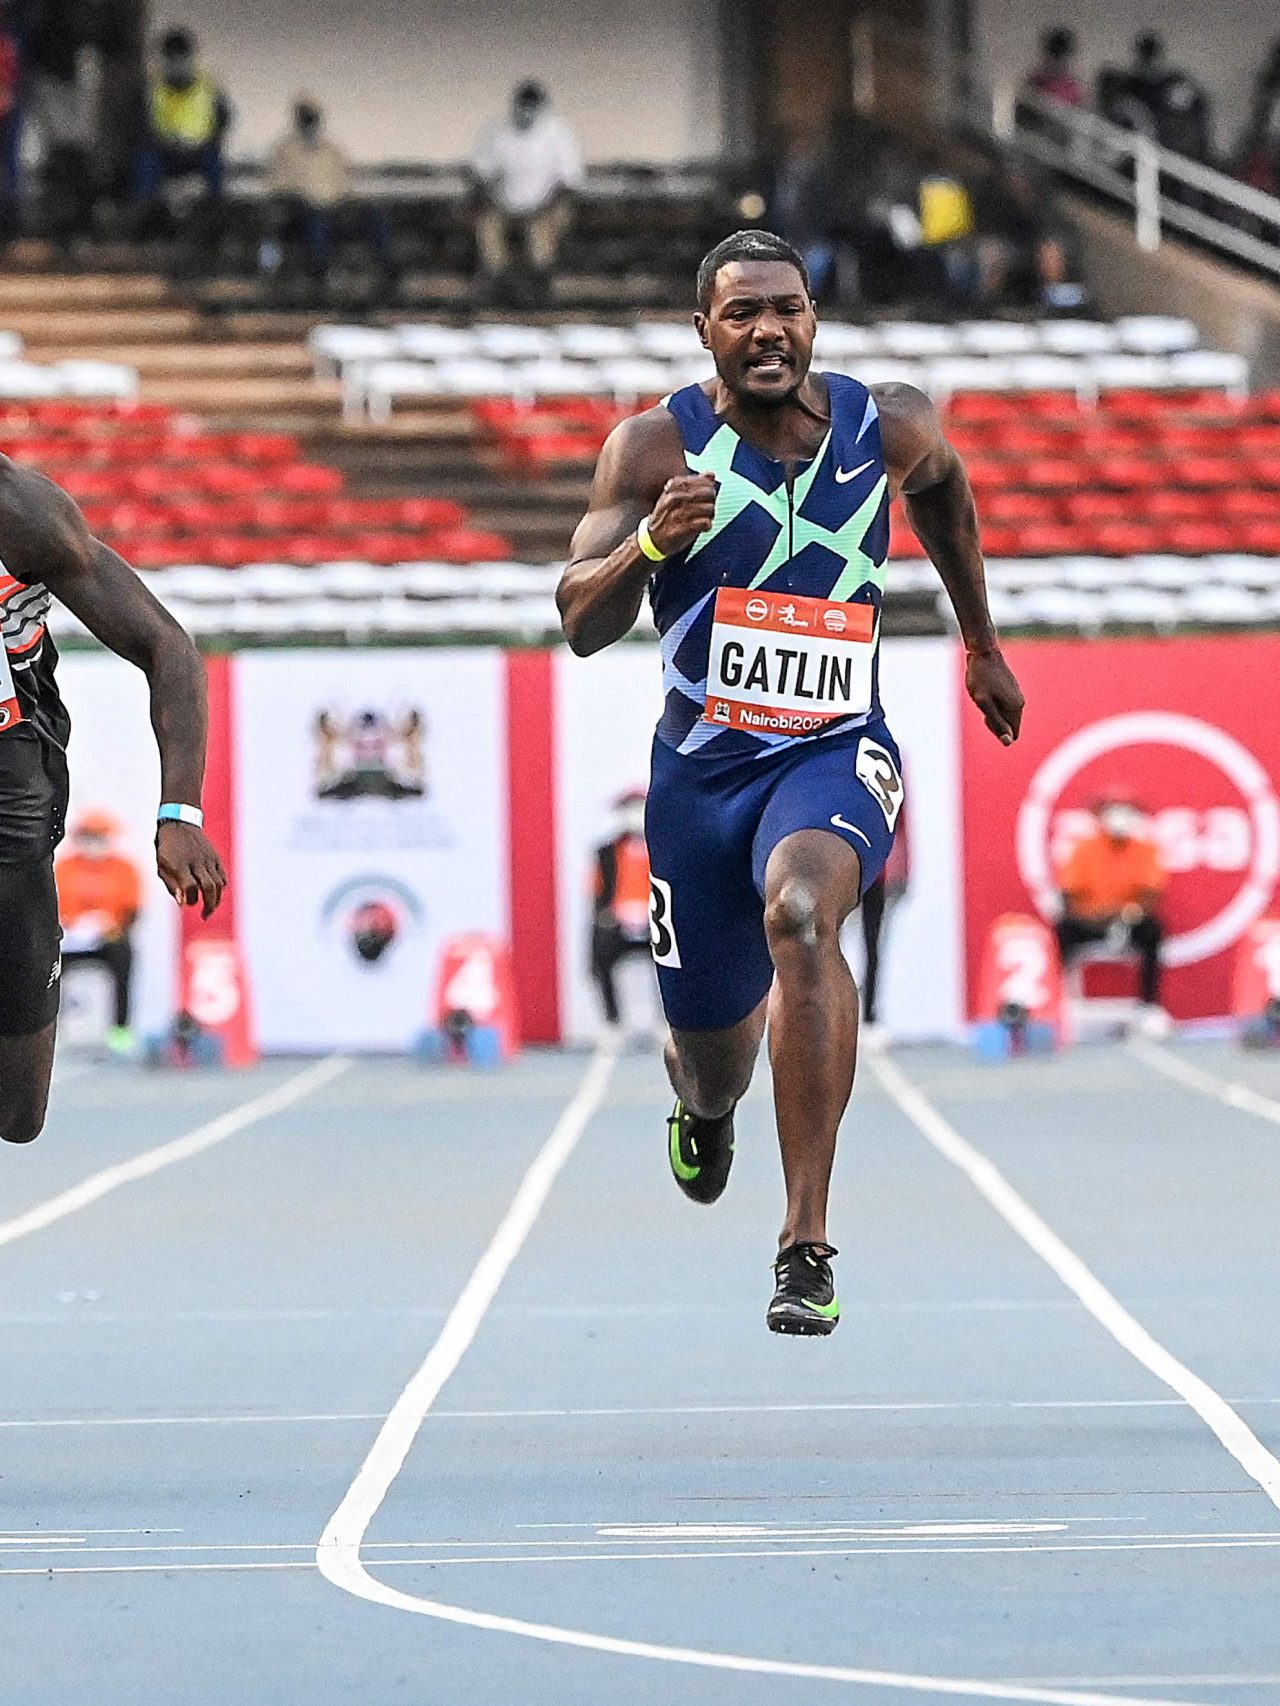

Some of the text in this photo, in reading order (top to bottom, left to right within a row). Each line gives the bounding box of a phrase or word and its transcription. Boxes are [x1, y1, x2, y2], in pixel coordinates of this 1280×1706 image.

[719, 641, 852, 701] GATLIN
[739, 709, 830, 731] Nairobi202
[445, 949, 499, 1014] 4
[998, 930, 1048, 1007] 2
